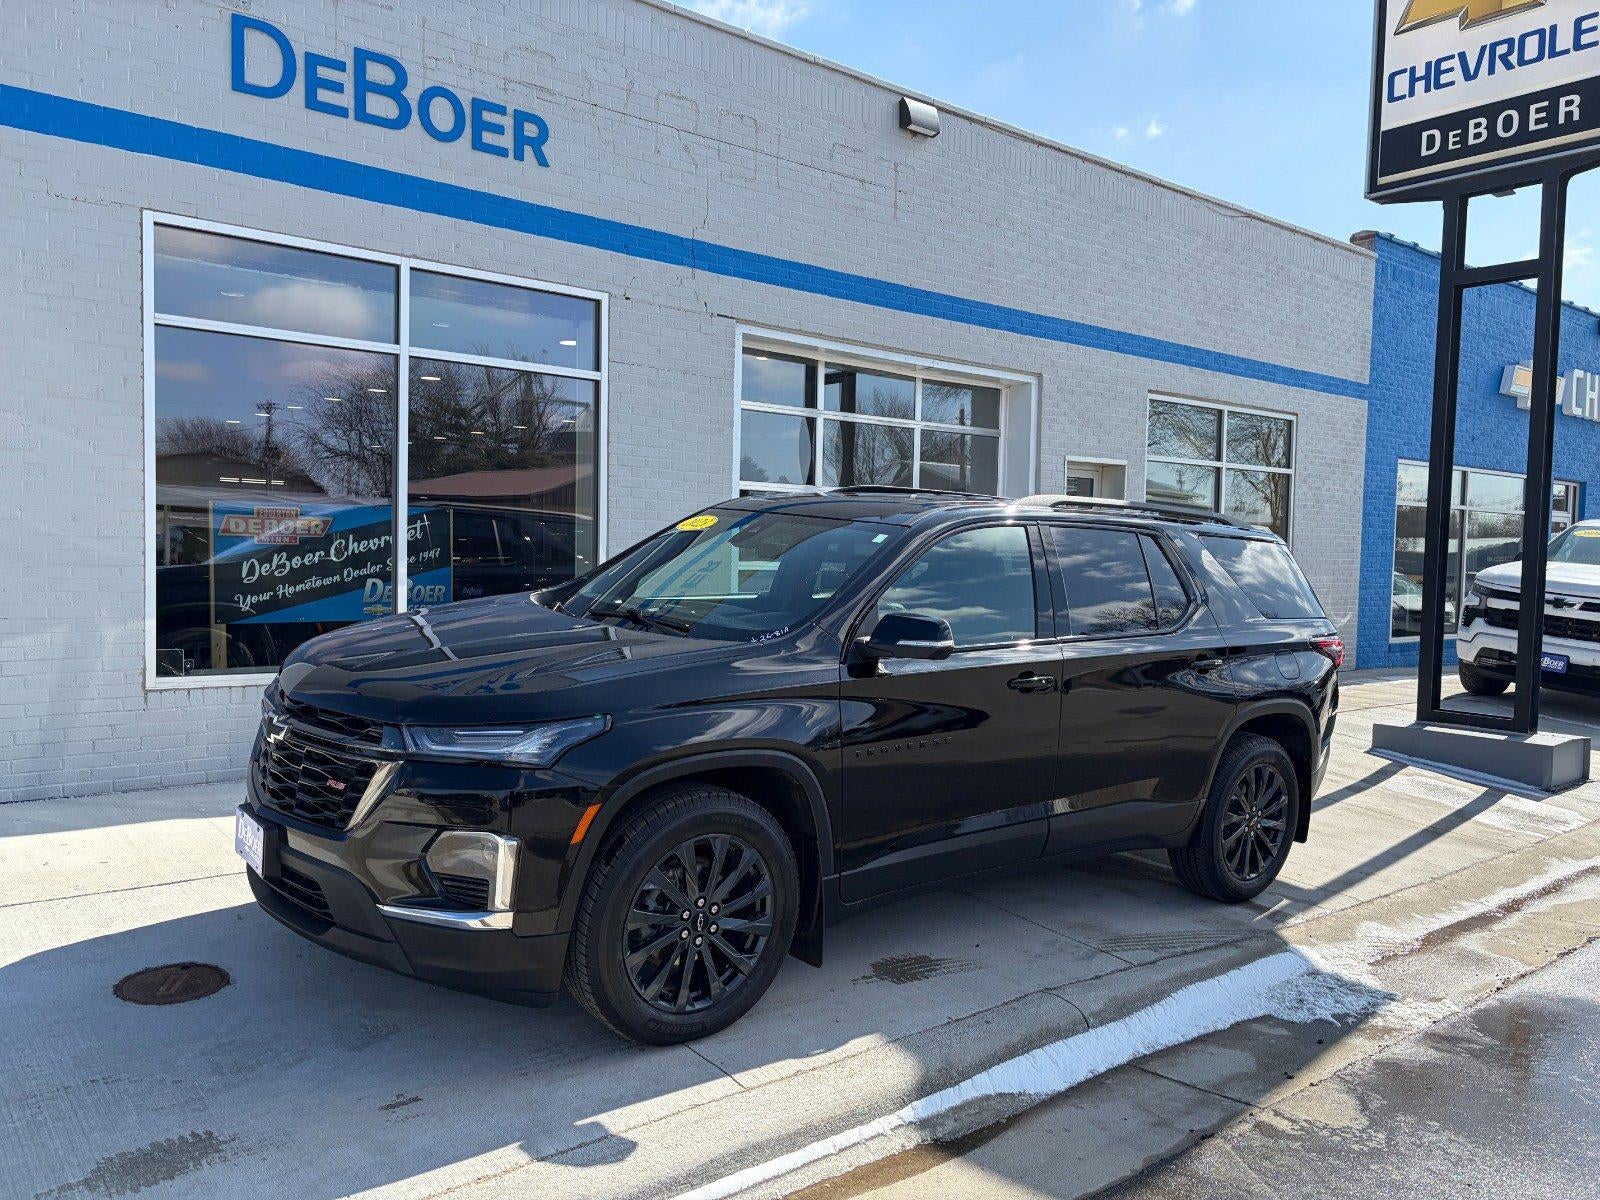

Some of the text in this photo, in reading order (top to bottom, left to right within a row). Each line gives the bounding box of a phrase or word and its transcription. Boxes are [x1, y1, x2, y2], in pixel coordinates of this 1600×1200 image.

[229, 519, 324, 535] DEBOER
[241, 519, 430, 584] DeBoer Chevret
[234, 589, 273, 612] Your
[276, 574, 341, 599] Hometown
[343, 562, 383, 582] Dealer
[418, 547, 441, 563] 1947
[855, 737, 952, 758] TRAVERSE
